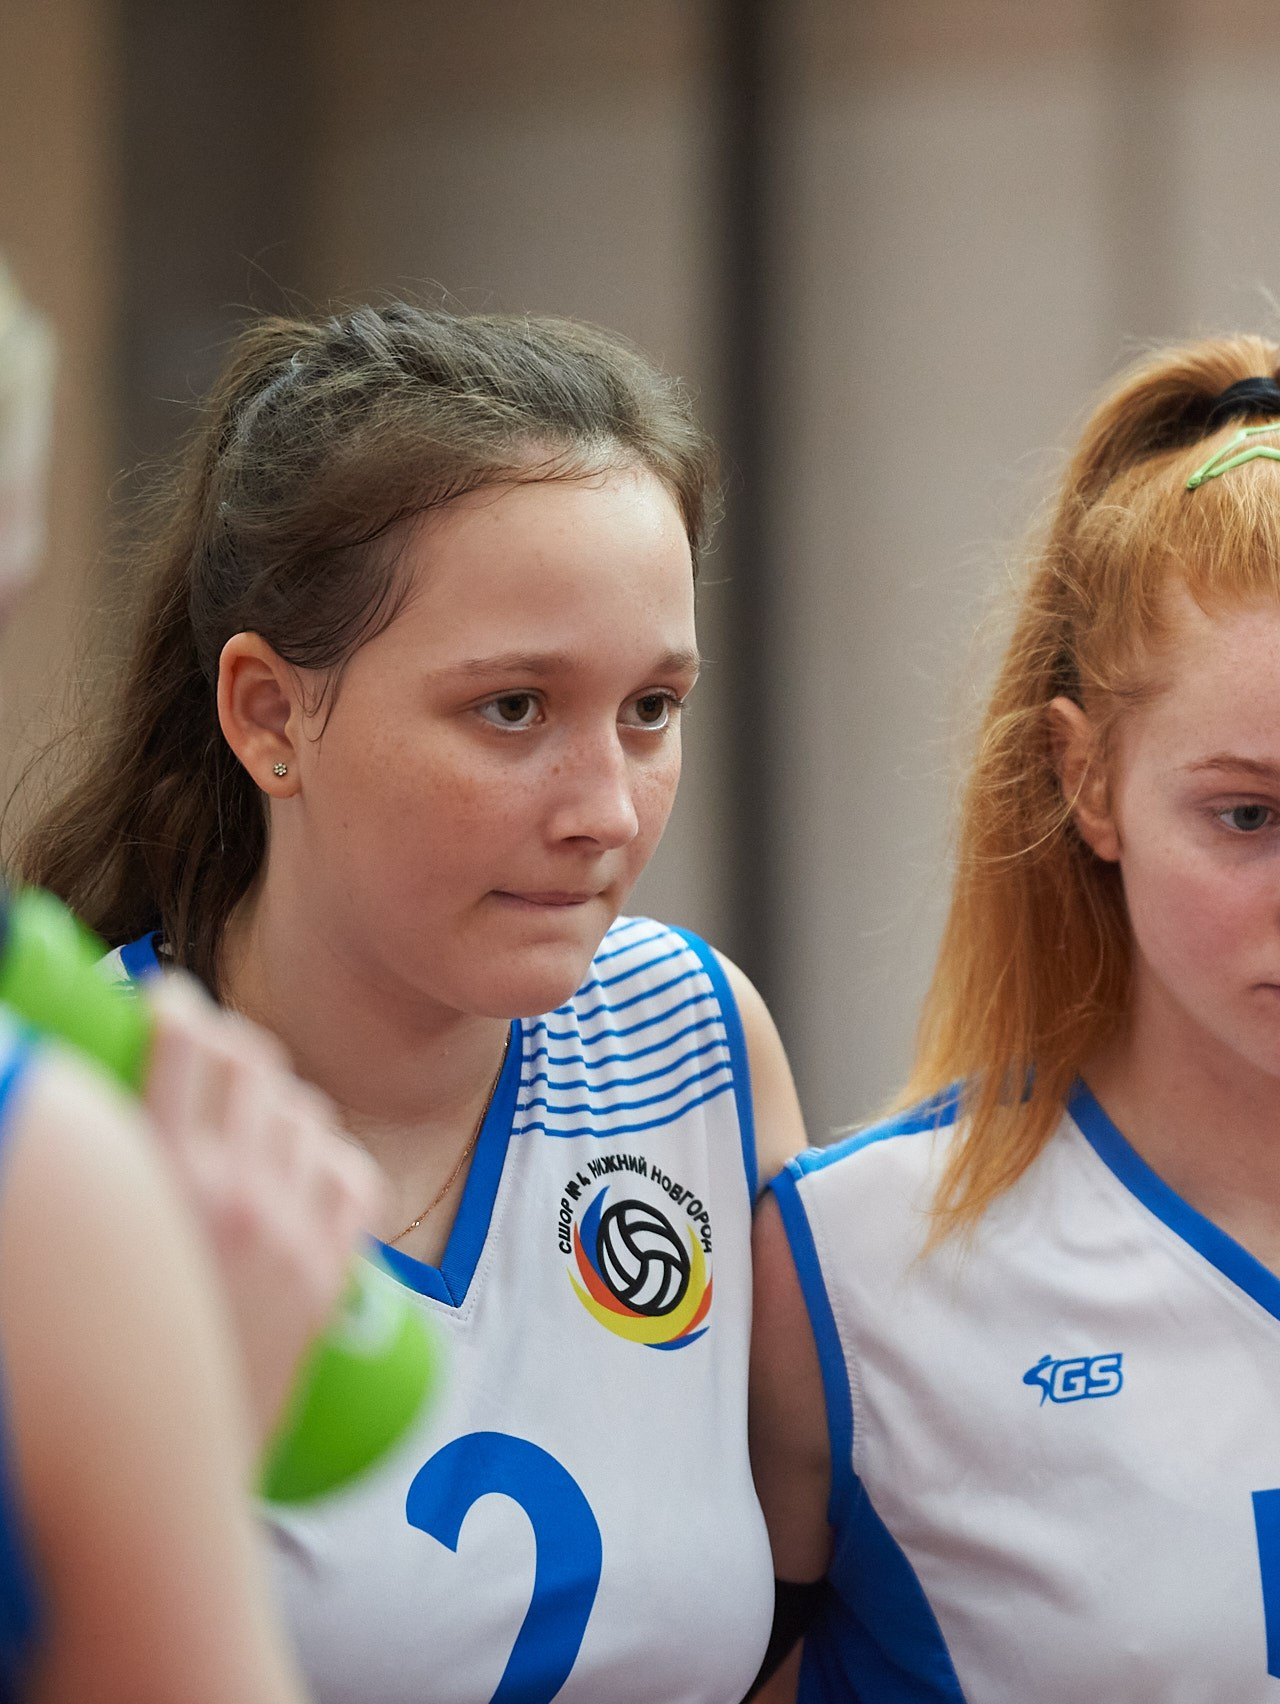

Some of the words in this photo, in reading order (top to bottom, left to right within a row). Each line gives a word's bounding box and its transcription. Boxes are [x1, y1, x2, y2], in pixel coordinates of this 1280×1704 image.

[558, 1197, 575, 1255] СШОР
[587, 1153, 648, 1179] НИЖНИЙ
[650, 1165, 713, 1254] НОВГОРОД
[1048, 1352, 1123, 1404] GS
[405, 1431, 603, 1704] 2
